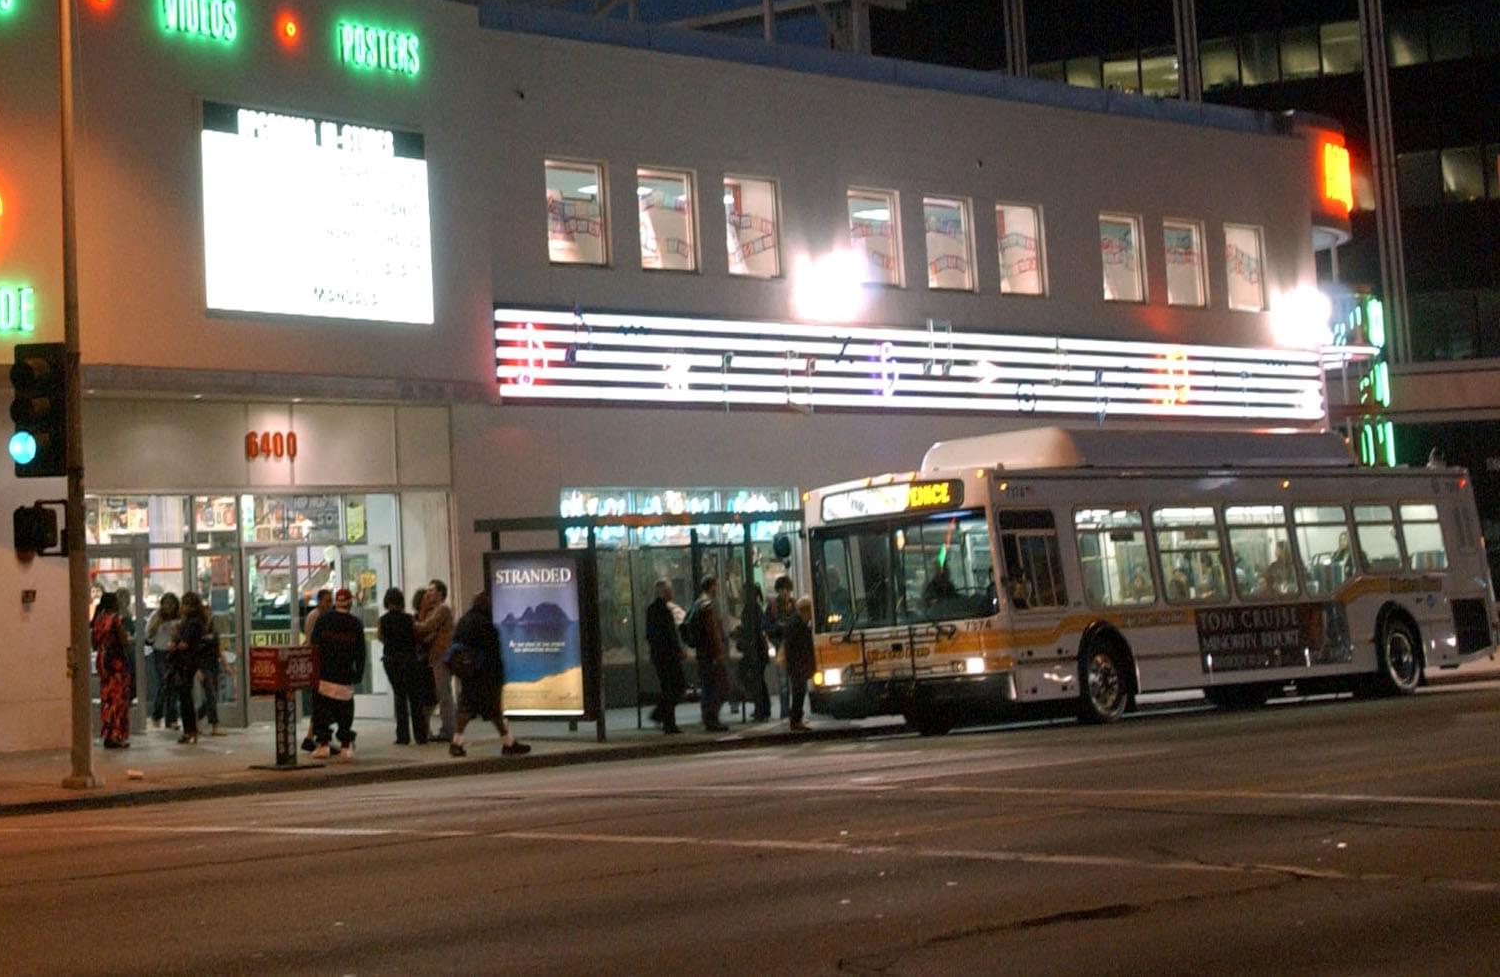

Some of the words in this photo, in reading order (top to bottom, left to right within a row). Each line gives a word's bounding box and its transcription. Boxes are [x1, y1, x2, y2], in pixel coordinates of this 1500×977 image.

[339, 22, 421, 76] POSTERS
[246, 431, 297, 459] 6400
[495, 567, 572, 584] STRANDED
